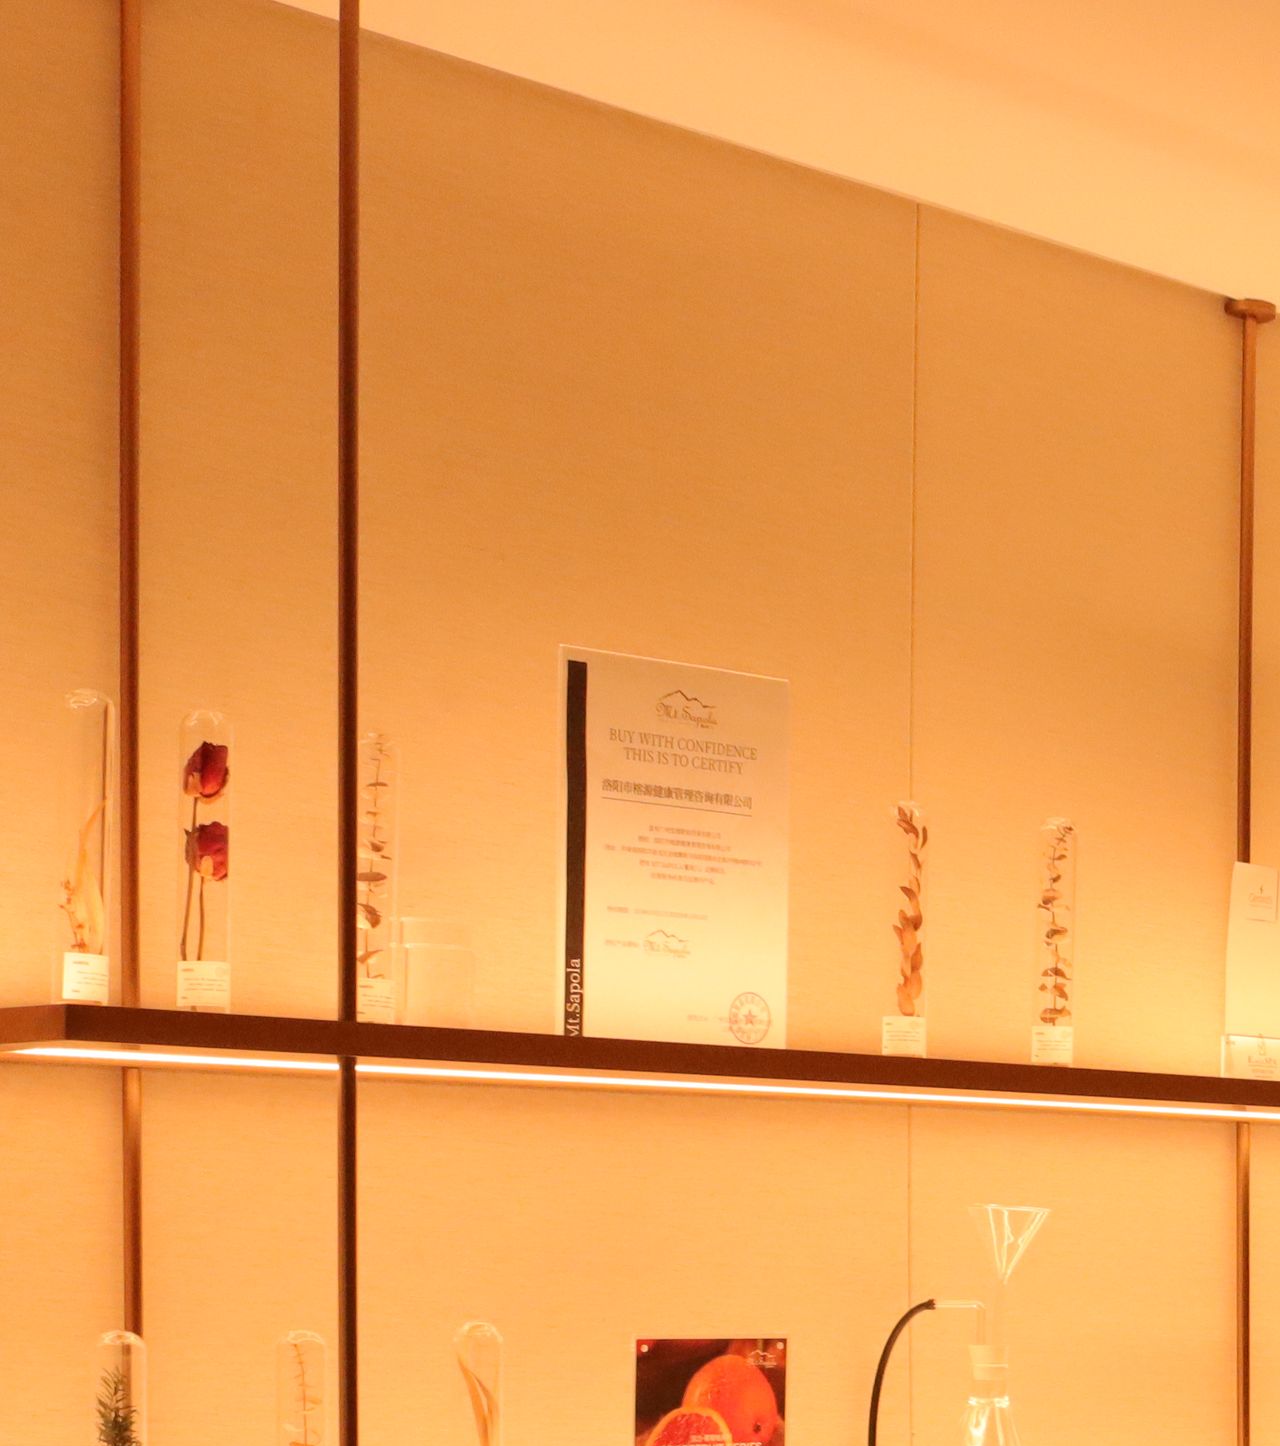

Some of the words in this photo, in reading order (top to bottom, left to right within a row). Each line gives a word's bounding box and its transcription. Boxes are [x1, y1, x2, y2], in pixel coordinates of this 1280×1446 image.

[609, 727, 636, 745] BUY
[639, 731, 675, 750] WITH
[677, 735, 759, 762] CONFIDENCE
[623, 746, 655, 764] THIS
[656, 750, 670, 766] IS
[670, 752, 690, 769] TO
[690, 755, 745, 776] CERTIFY
